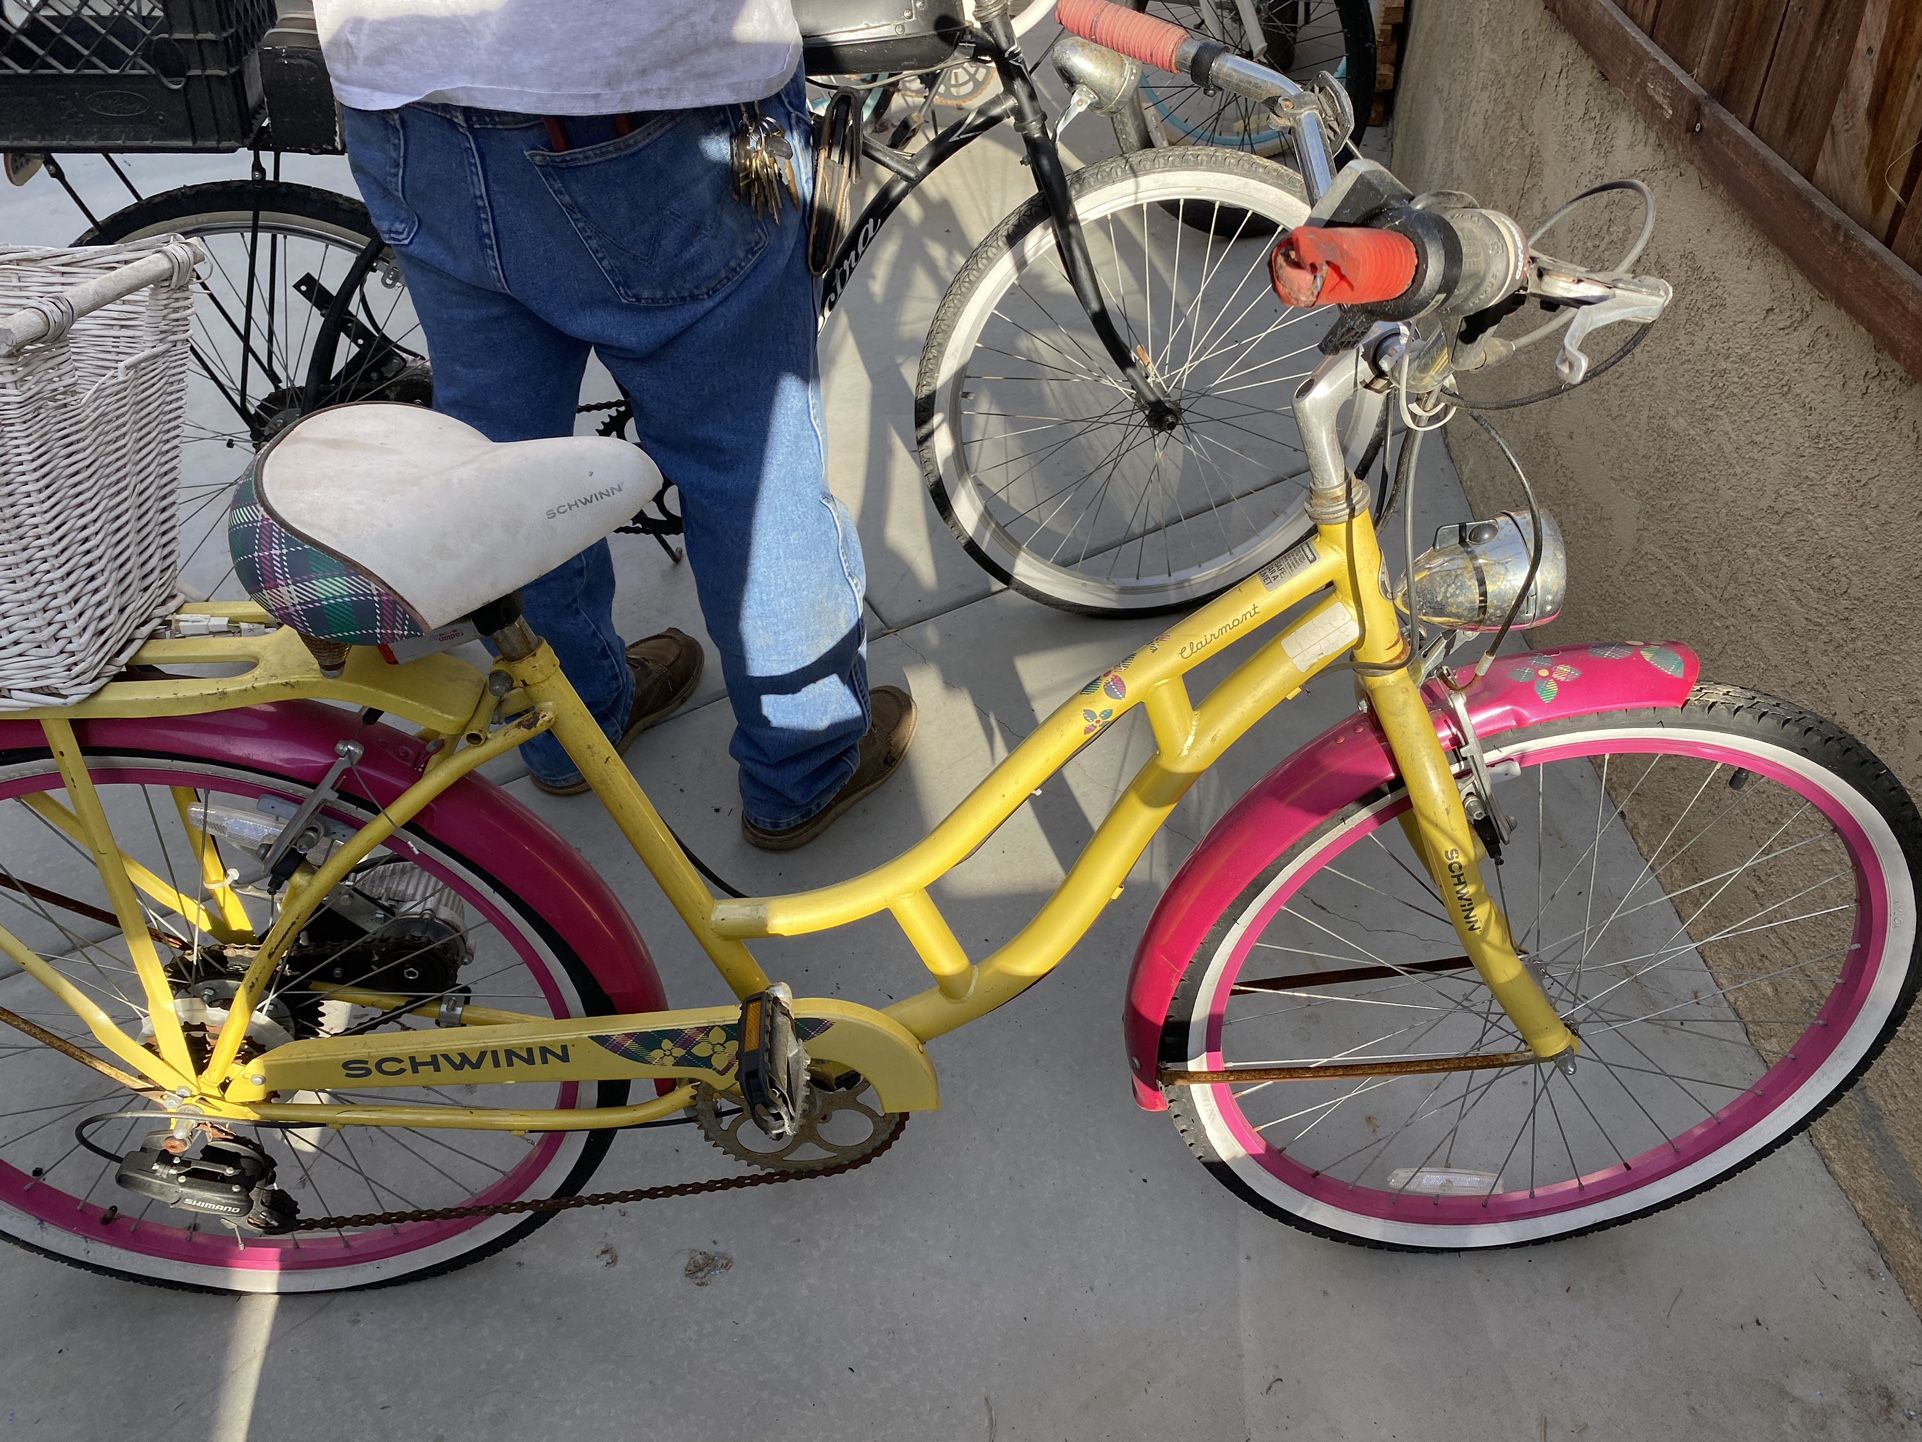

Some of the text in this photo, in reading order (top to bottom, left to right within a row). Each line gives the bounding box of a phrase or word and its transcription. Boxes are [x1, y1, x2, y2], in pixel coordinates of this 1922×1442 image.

[545, 483, 624, 520] SCHWINN
[1178, 603, 1260, 659] Clairmont
[1444, 848, 1482, 933] SCHWINN
[341, 1044, 571, 1079] SCHWINN
[183, 1198, 241, 1213] SHIMANO
